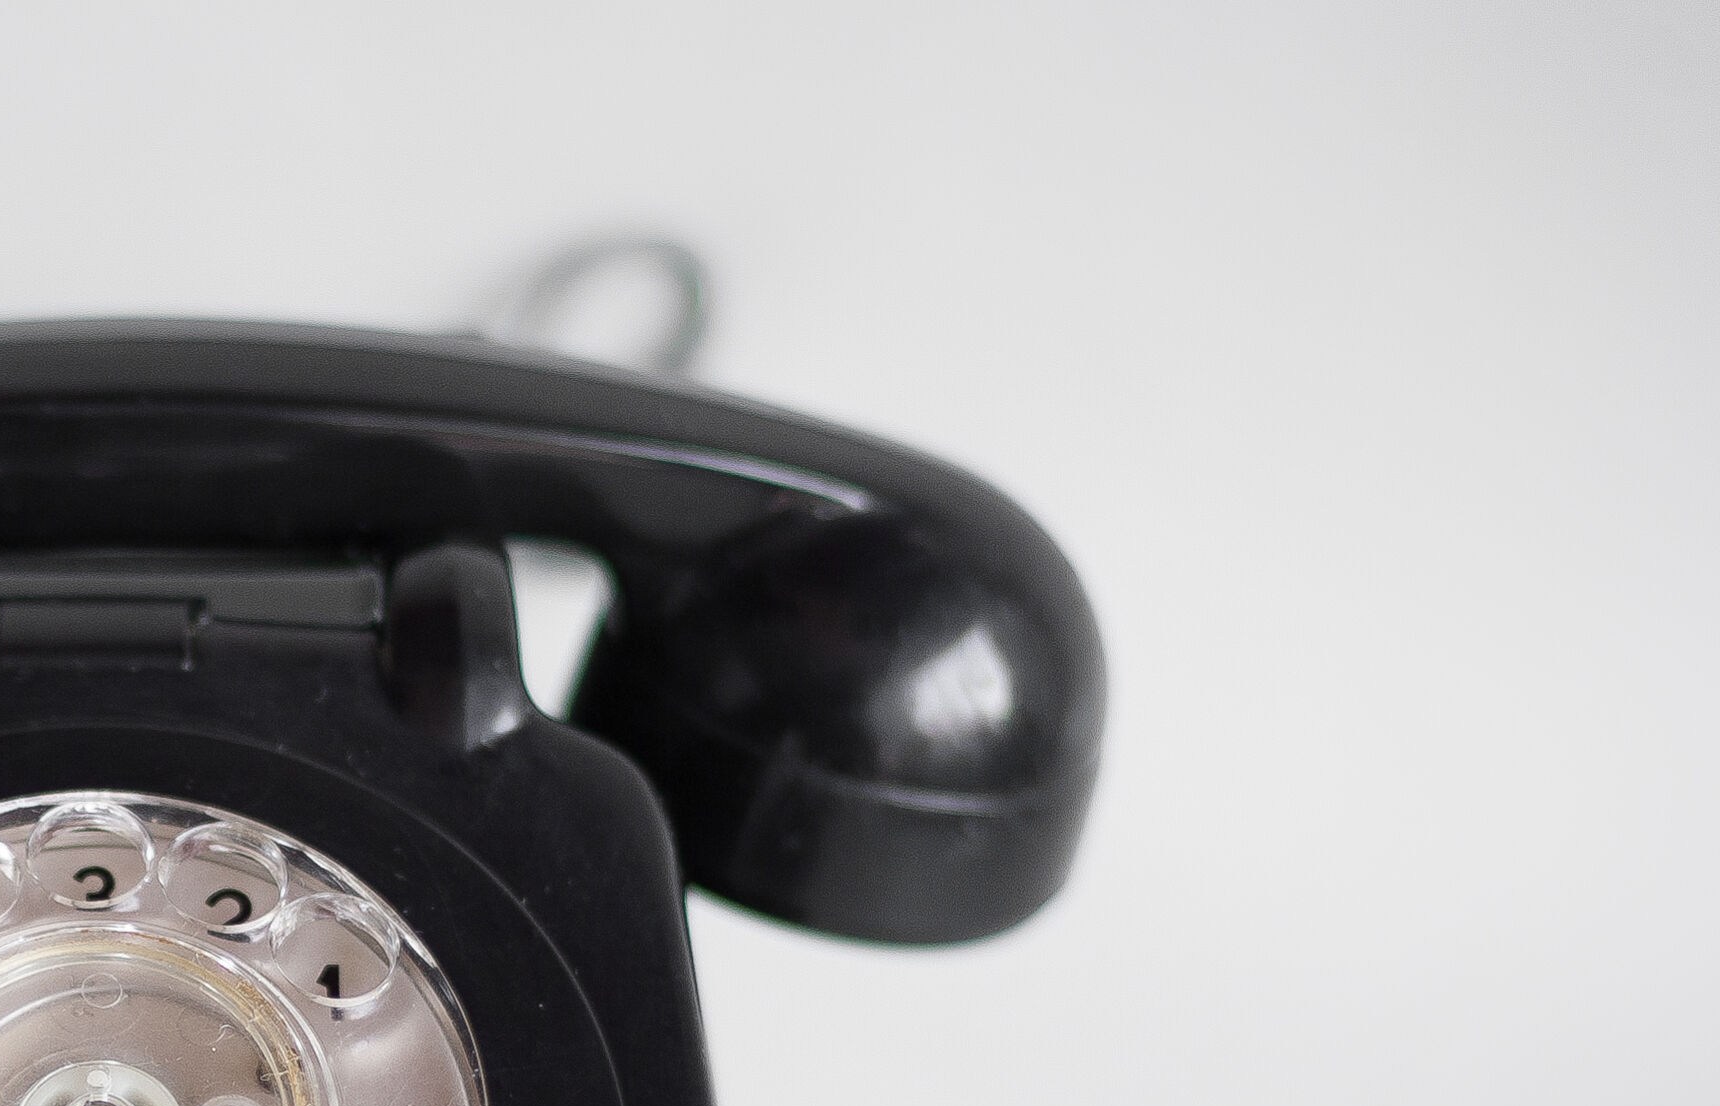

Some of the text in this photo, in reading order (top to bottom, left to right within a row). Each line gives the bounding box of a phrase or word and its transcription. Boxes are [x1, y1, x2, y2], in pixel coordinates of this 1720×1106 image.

[72, 865, 116, 909] 3
[205, 888, 253, 942] 2
[316, 964, 342, 1017] 1
